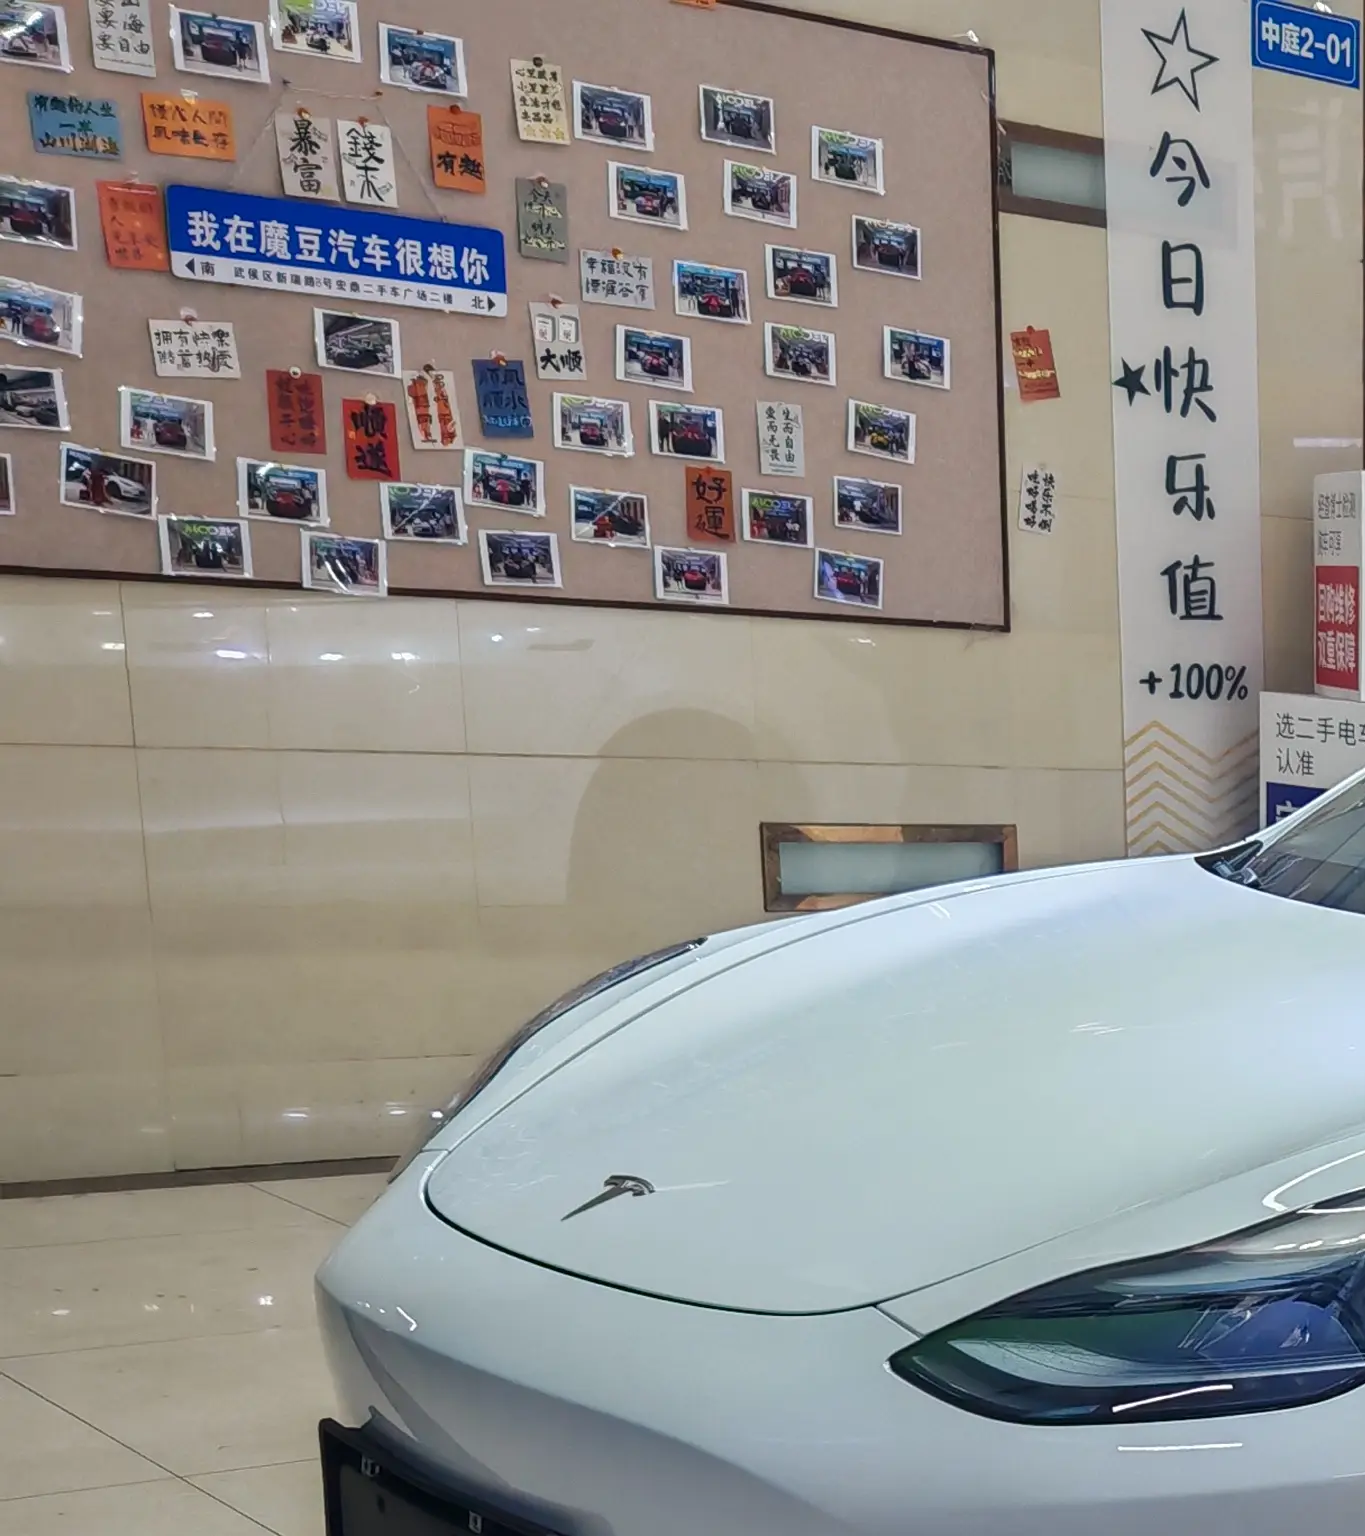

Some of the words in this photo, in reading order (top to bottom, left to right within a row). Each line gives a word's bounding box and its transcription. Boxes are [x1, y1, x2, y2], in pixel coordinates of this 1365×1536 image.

[1260, 16, 1351, 68] 中庭2-01
[289, 118, 323, 195] 暴富
[436, 152, 485, 182] 有趣
[186, 210, 490, 286] 我在魔豆汽车很想你
[200, 261, 216, 277] 南
[471, 295, 486, 310] 北
[1149, 129, 1225, 623] 今日快乐值
[1140, 662, 1249, 703] +100%
[1275, 750, 1316, 777] 认准
